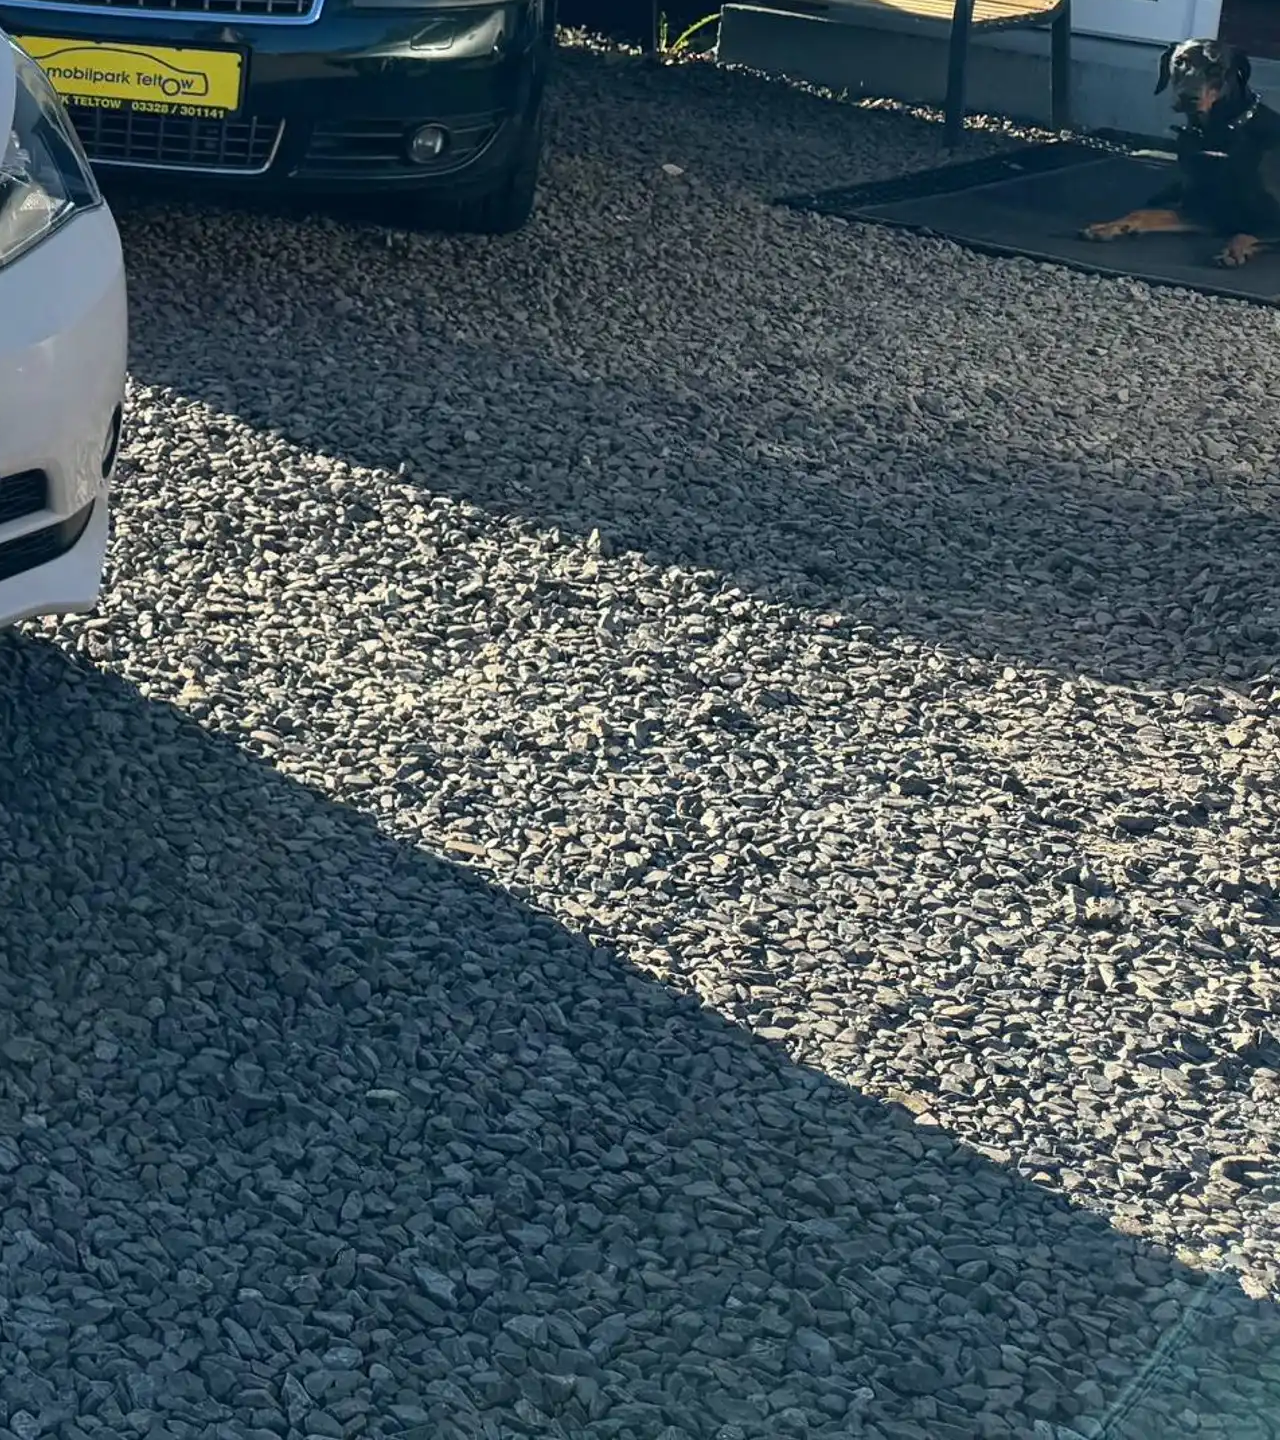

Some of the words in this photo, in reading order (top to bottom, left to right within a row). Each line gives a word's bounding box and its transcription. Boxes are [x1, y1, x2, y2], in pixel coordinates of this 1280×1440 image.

[73, 95, 122, 109] TELTOW
[132, 102, 169, 114] 03328
[180, 105, 225, 119] 301141
